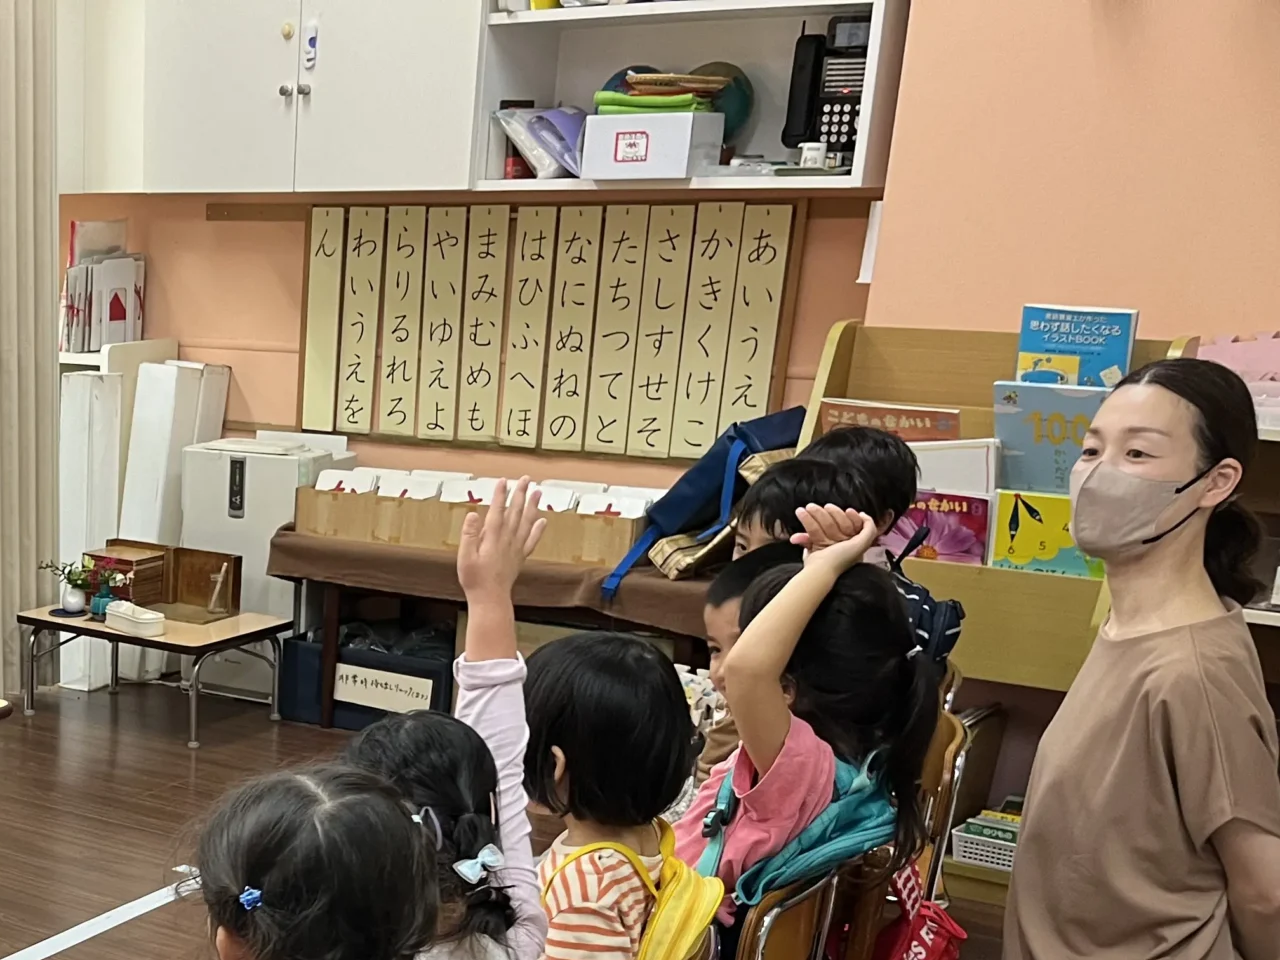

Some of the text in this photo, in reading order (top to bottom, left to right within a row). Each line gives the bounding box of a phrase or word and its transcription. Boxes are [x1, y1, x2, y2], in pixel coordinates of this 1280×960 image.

[315, 229, 336, 258] ん
[344, 229, 377, 425] わいうえを
[386, 227, 414, 426] らりるれろ
[426, 230, 459, 430] やいゆえよ
[466, 228, 498, 432] まみむめも
[508, 230, 547, 436] はひふへほ
[550, 233, 592, 439] なにぬねの
[596, 231, 638, 444] たちつてと
[637, 229, 680, 447] さしすせそ
[685, 229, 733, 447] かきくけこ
[1030, 320, 1122, 336] 思わず話したくなる
[1042, 333, 1107, 345] イラストBOOK
[1008, 544, 1015, 555] 6
[1039, 541, 1046, 551] 5
